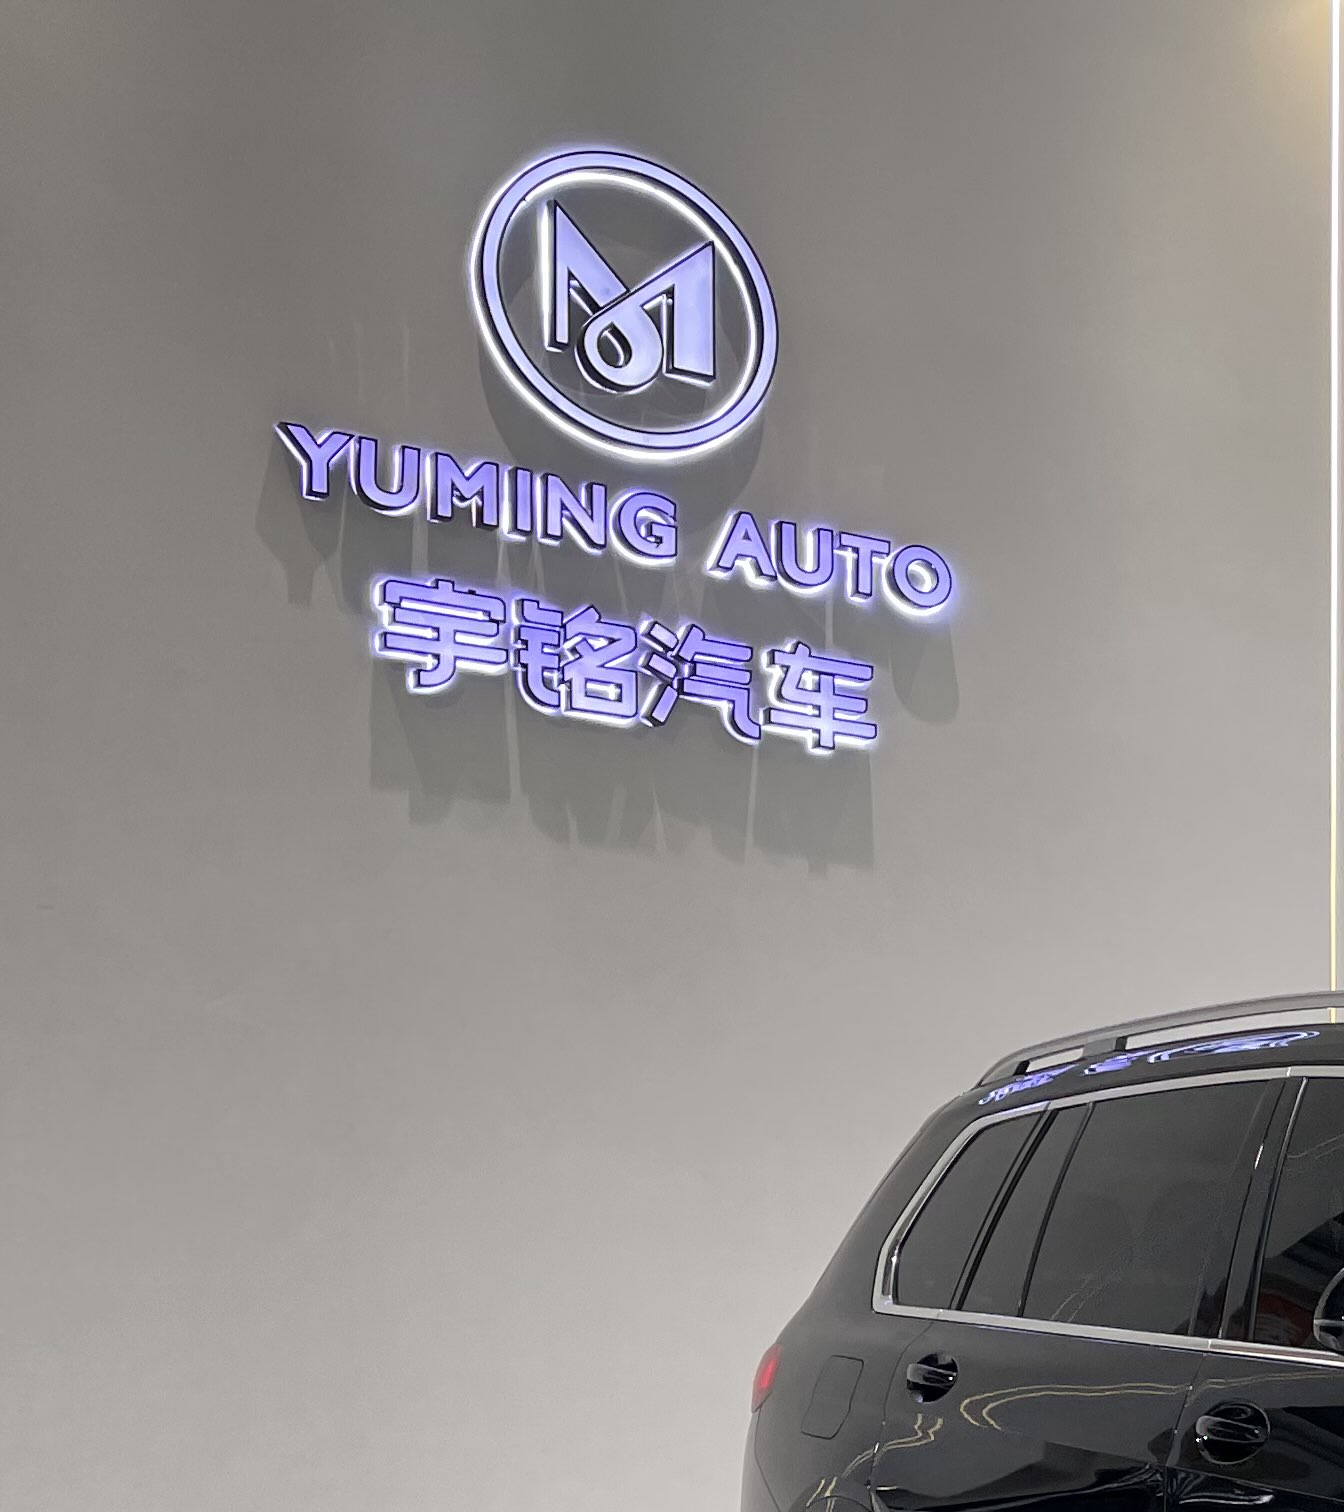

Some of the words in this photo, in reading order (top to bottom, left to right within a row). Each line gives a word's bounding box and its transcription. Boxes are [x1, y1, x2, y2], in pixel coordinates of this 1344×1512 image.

[277, 420, 678, 562] YUMING
[708, 511, 954, 619] AUTO
[372, 577, 881, 754] 宇铭汽车
